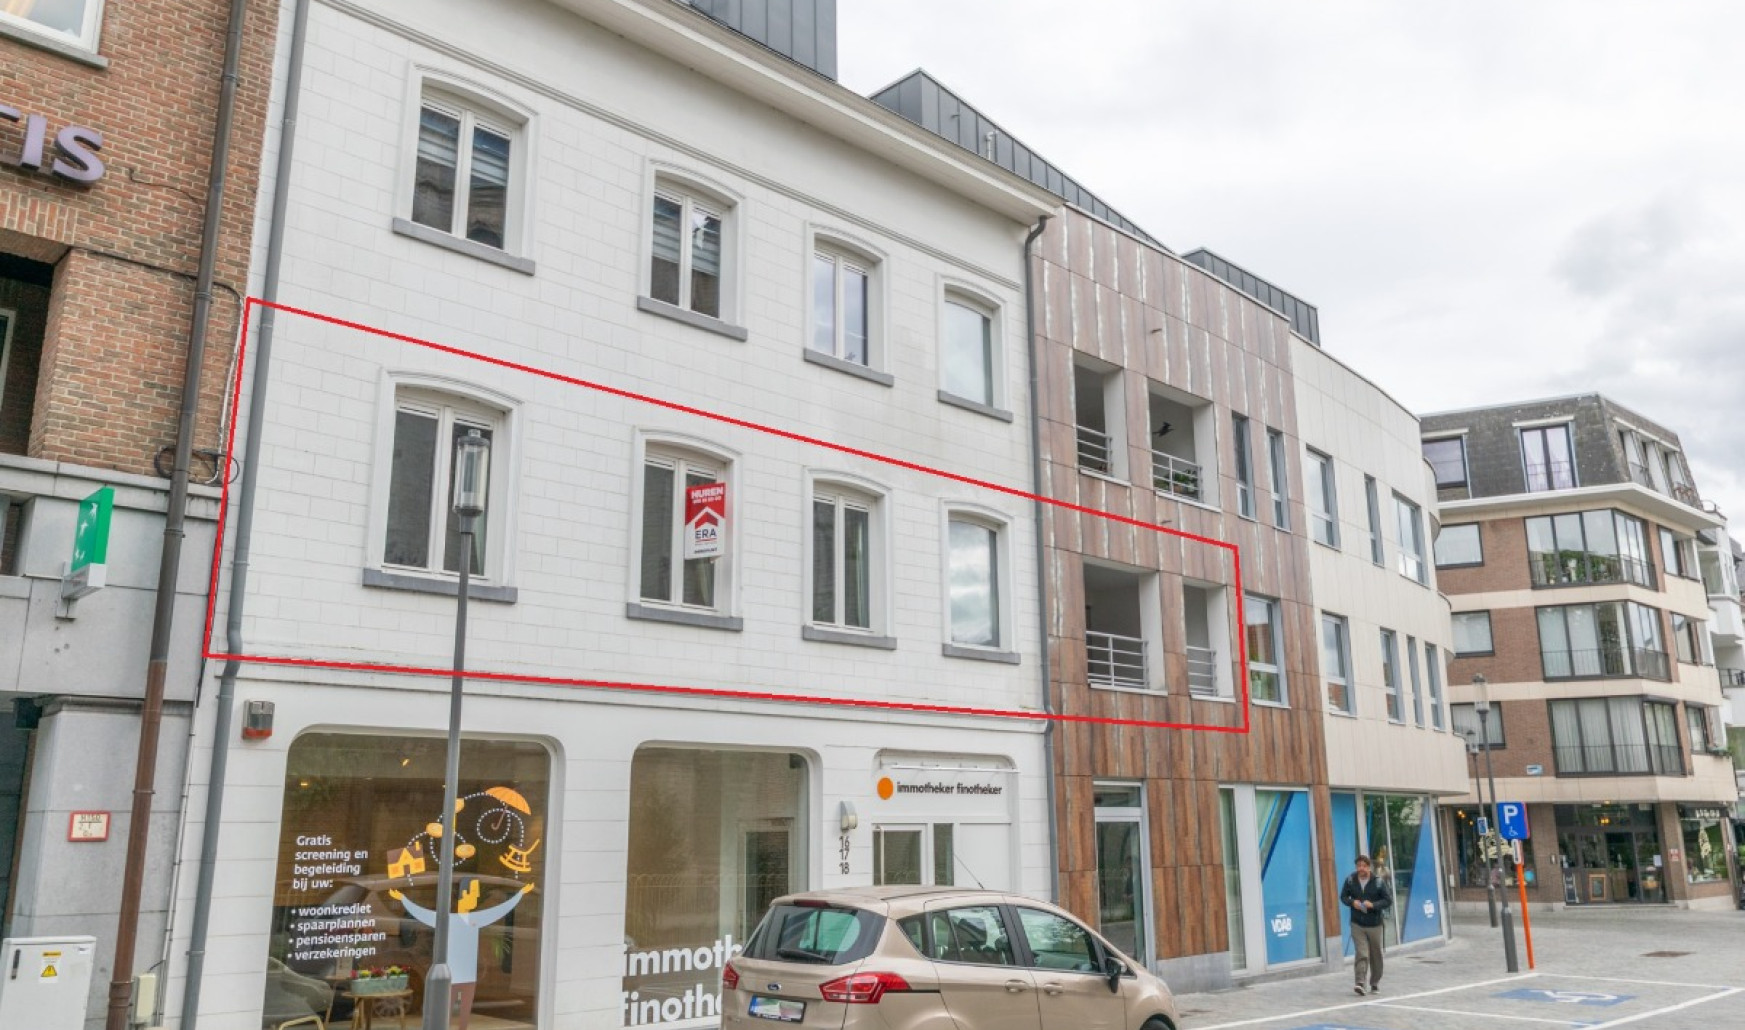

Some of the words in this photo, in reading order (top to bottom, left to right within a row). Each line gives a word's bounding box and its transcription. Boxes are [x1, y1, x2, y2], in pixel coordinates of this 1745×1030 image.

[695, 528, 717, 539] ERA
[897, 782, 954, 794] immotheker
[957, 782, 1002, 795] finotheker
[1503, 804, 1518, 824] P
[296, 834, 332, 846] Gratis
[294, 848, 351, 861] screening
[354, 850, 369, 859] en
[294, 862, 361, 877] begeleiding
[839, 862, 850, 875] 18
[293, 878, 308, 891] bij
[311, 879, 334, 888] uw:
[298, 902, 372, 916] woonkrediet
[297, 918, 376, 935] spaarplannen
[296, 931, 386, 949] pensioensparen
[294, 946, 376, 961] verzekeringen
[617, 983, 721, 1027] finoth
